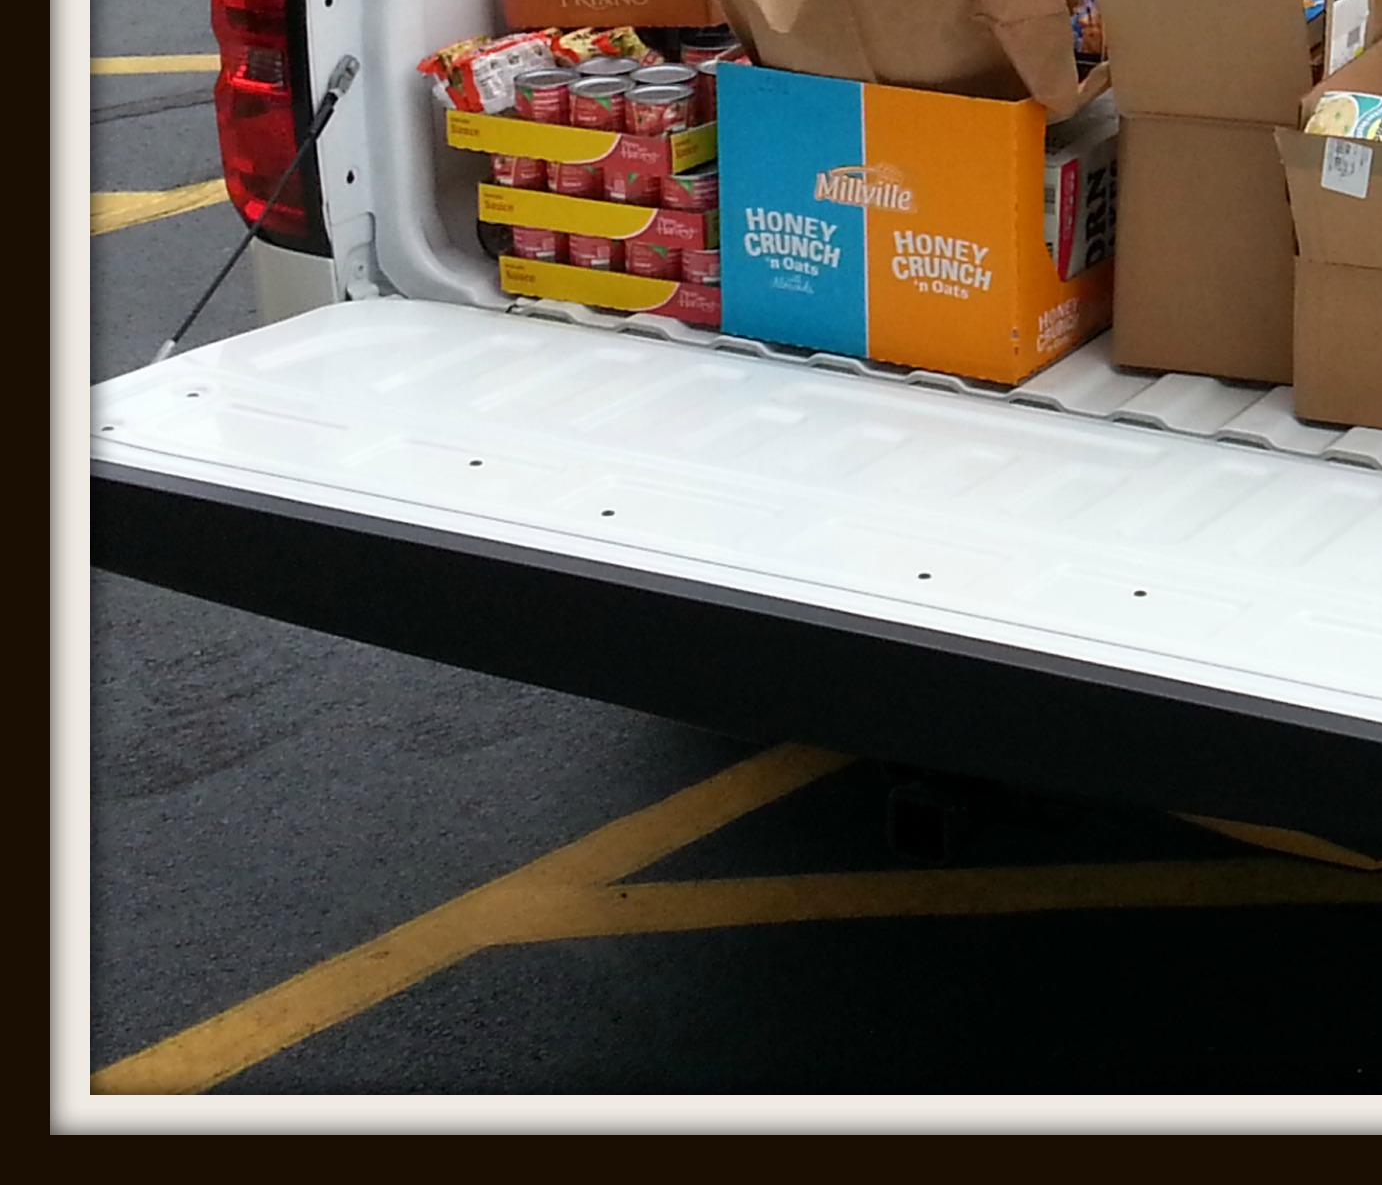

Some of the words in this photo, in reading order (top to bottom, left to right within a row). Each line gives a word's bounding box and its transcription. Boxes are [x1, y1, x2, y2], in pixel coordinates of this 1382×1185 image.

[815, 172, 914, 211] Millville
[745, 207, 838, 243] HONEY
[744, 233, 841, 269] CRUNCH
[893, 230, 990, 265] HONEY
[783, 257, 820, 276] Oats
[892, 255, 993, 291] CRUNCH
[931, 280, 970, 300] Oats
